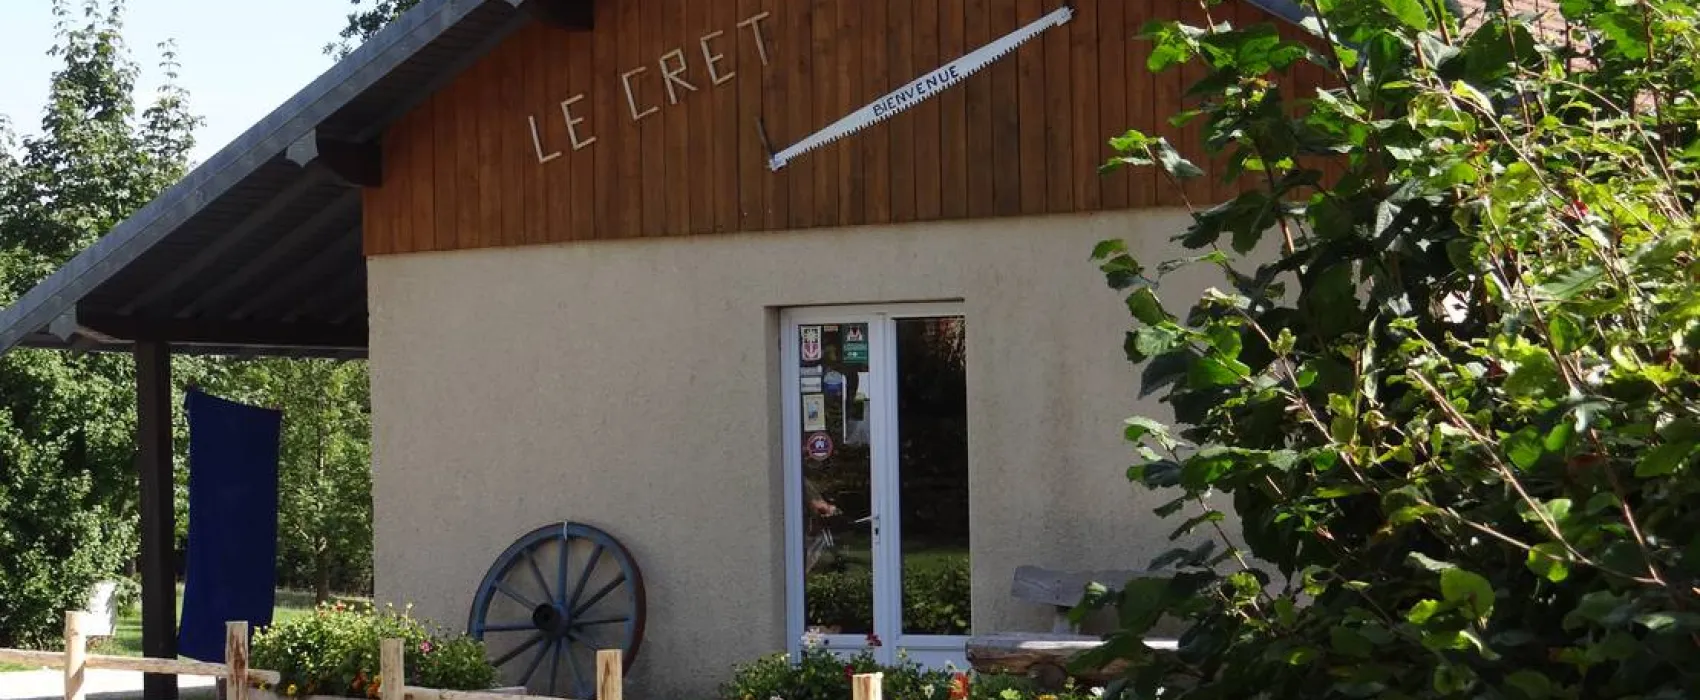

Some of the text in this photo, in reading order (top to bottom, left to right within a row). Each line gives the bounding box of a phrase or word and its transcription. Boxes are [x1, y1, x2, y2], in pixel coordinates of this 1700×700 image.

[528, 11, 770, 164] LE CRET
[872, 65, 959, 117] BIENVENUE
